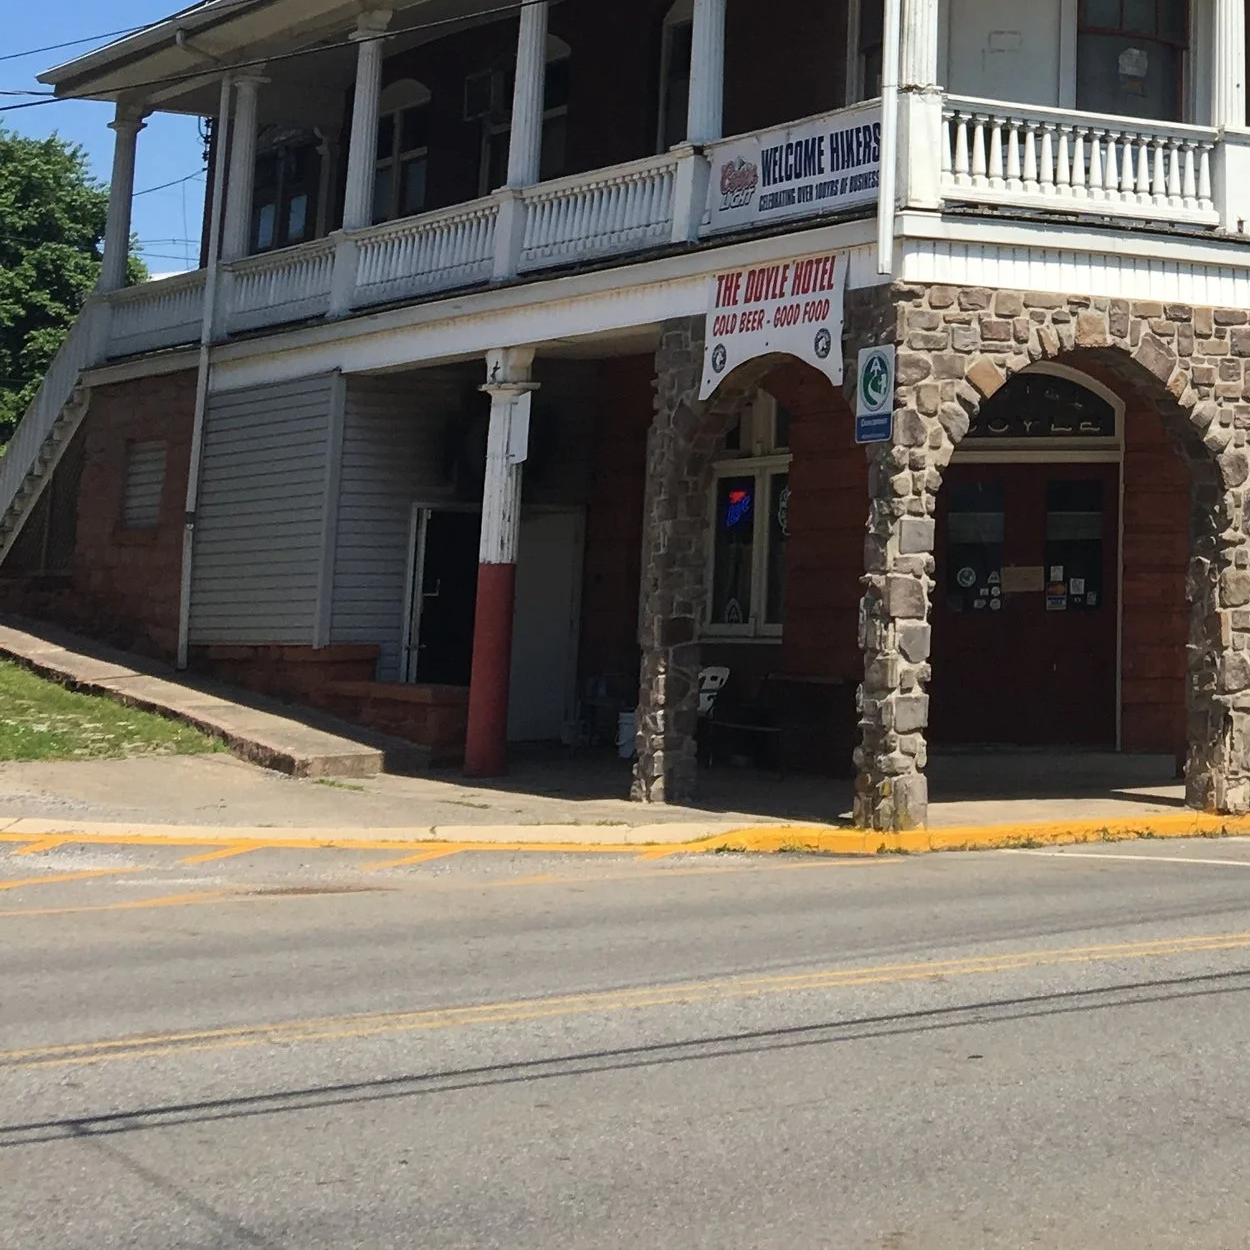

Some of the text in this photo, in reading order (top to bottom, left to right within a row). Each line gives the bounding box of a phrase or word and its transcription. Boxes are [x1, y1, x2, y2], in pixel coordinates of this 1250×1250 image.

[761, 122, 881, 187] WELCOME HIKERS
[758, 187, 796, 212] CELEBRATING
[797, 183, 814, 203] OVER
[840, 177, 849, 195] OF
[849, 170, 880, 193] BUSINESS
[715, 255, 836, 308] THE DOYLE HOTEL
[713, 313, 738, 337] COLD
[739, 308, 765, 333] BEER
[773, 303, 801, 328] GOOD
[802, 298, 830, 324] FOOD
